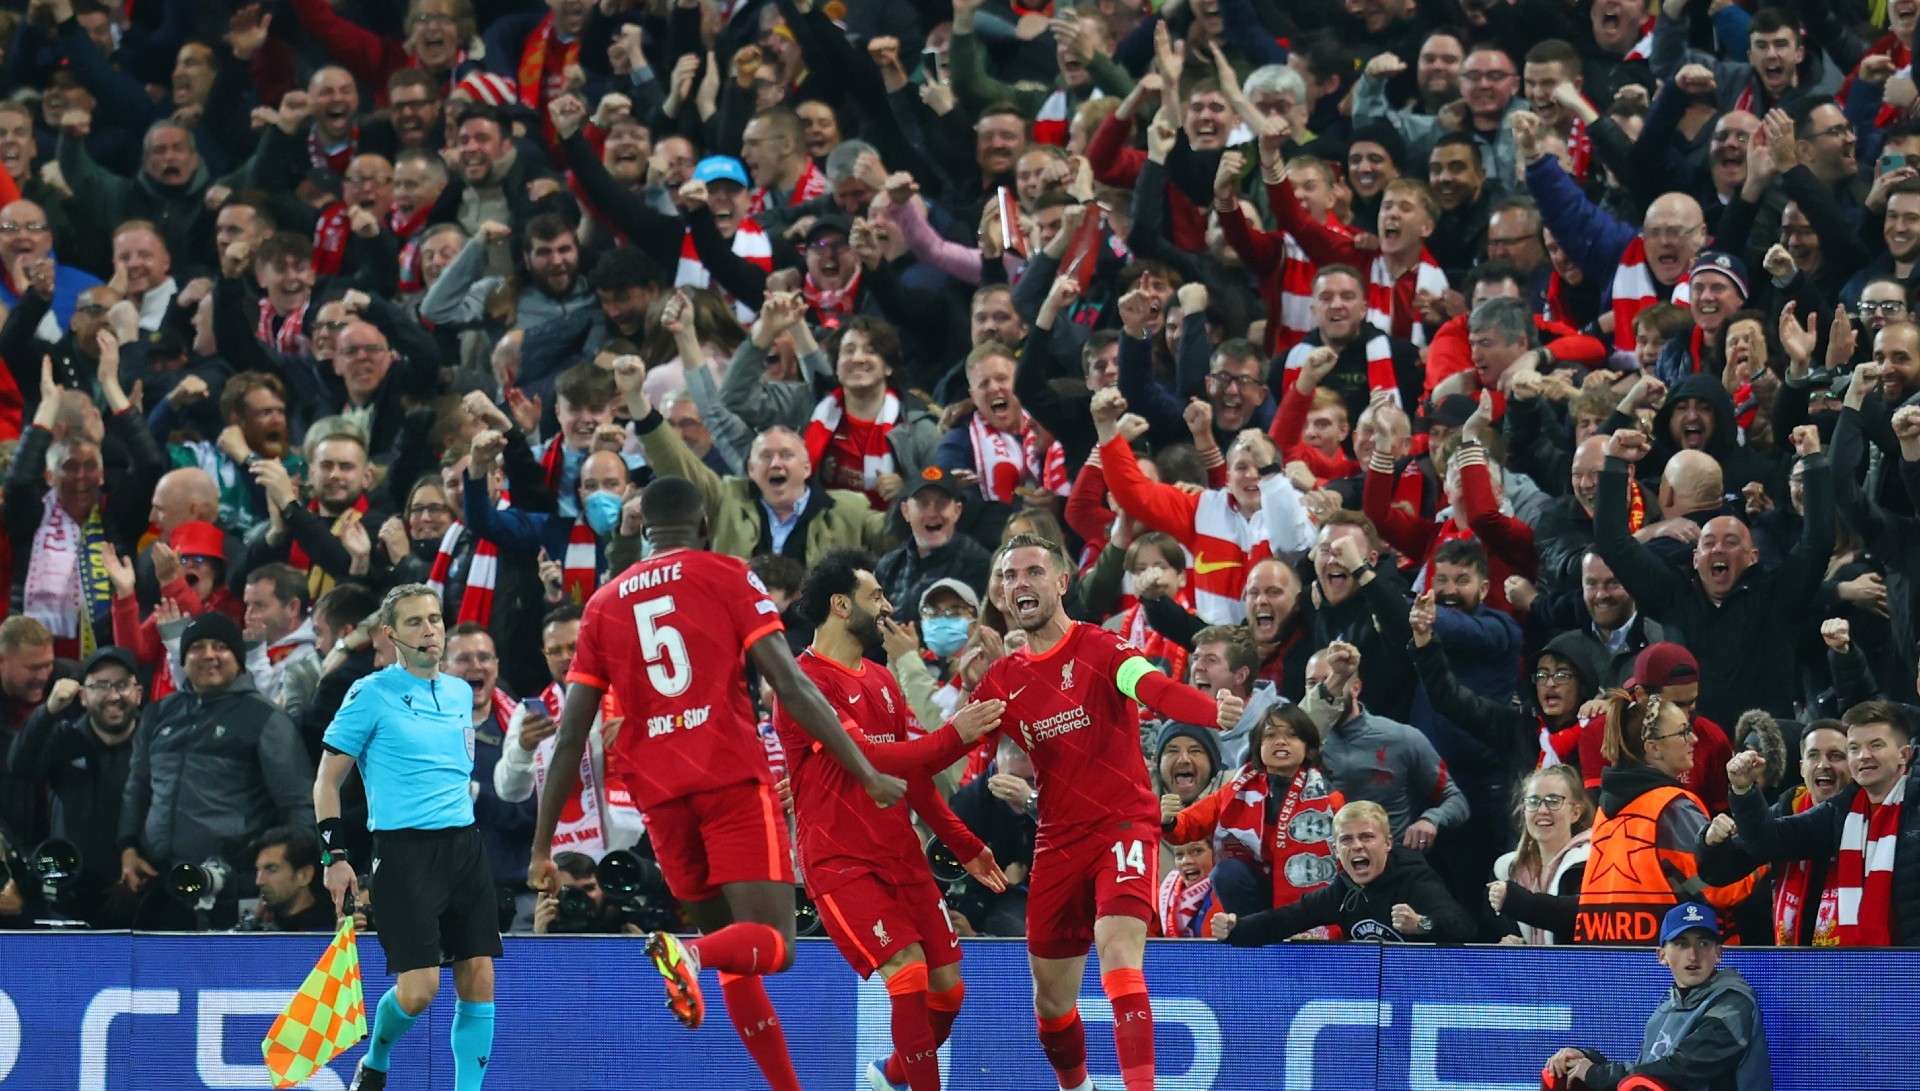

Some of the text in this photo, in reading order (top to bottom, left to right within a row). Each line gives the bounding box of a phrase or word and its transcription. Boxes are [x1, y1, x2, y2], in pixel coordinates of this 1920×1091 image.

[618, 562, 682, 599] KONATÉ
[633, 595, 692, 697] 5
[647, 714, 674, 738] SIDE
[1032, 705, 1085, 732] standard
[1035, 715, 1092, 744] chartered
[1276, 790, 1300, 849] SUCCESS
[1111, 839, 1145, 873] 14
